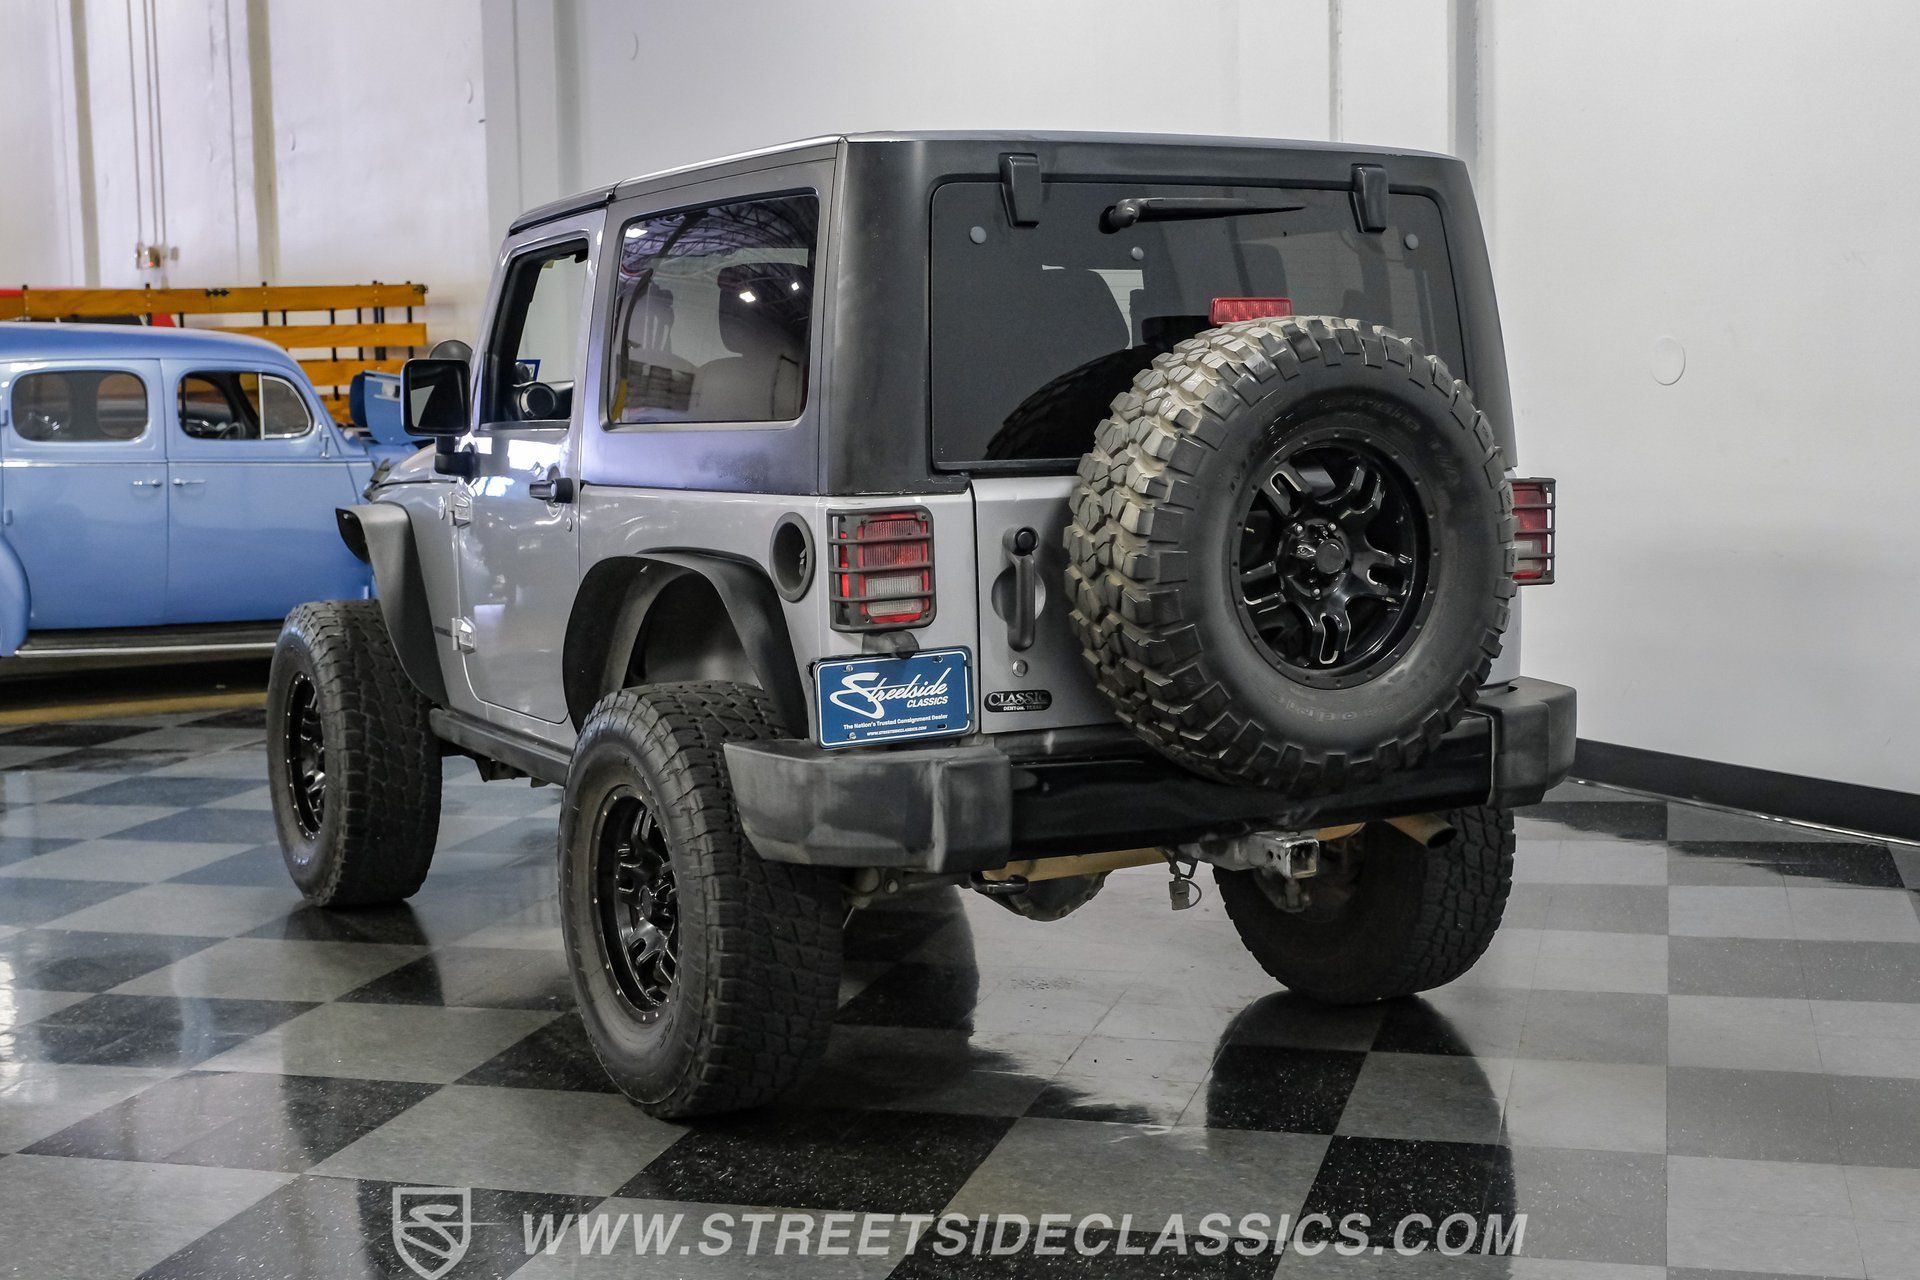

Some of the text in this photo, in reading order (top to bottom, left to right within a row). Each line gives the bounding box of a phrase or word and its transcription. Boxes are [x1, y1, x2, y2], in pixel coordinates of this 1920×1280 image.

[829, 667, 952, 719] Streetside
[906, 696, 949, 708] CLASSICS
[854, 721, 876, 729] Nation's
[877, 719, 897, 727] Trusted
[897, 716, 931, 725] Consignment
